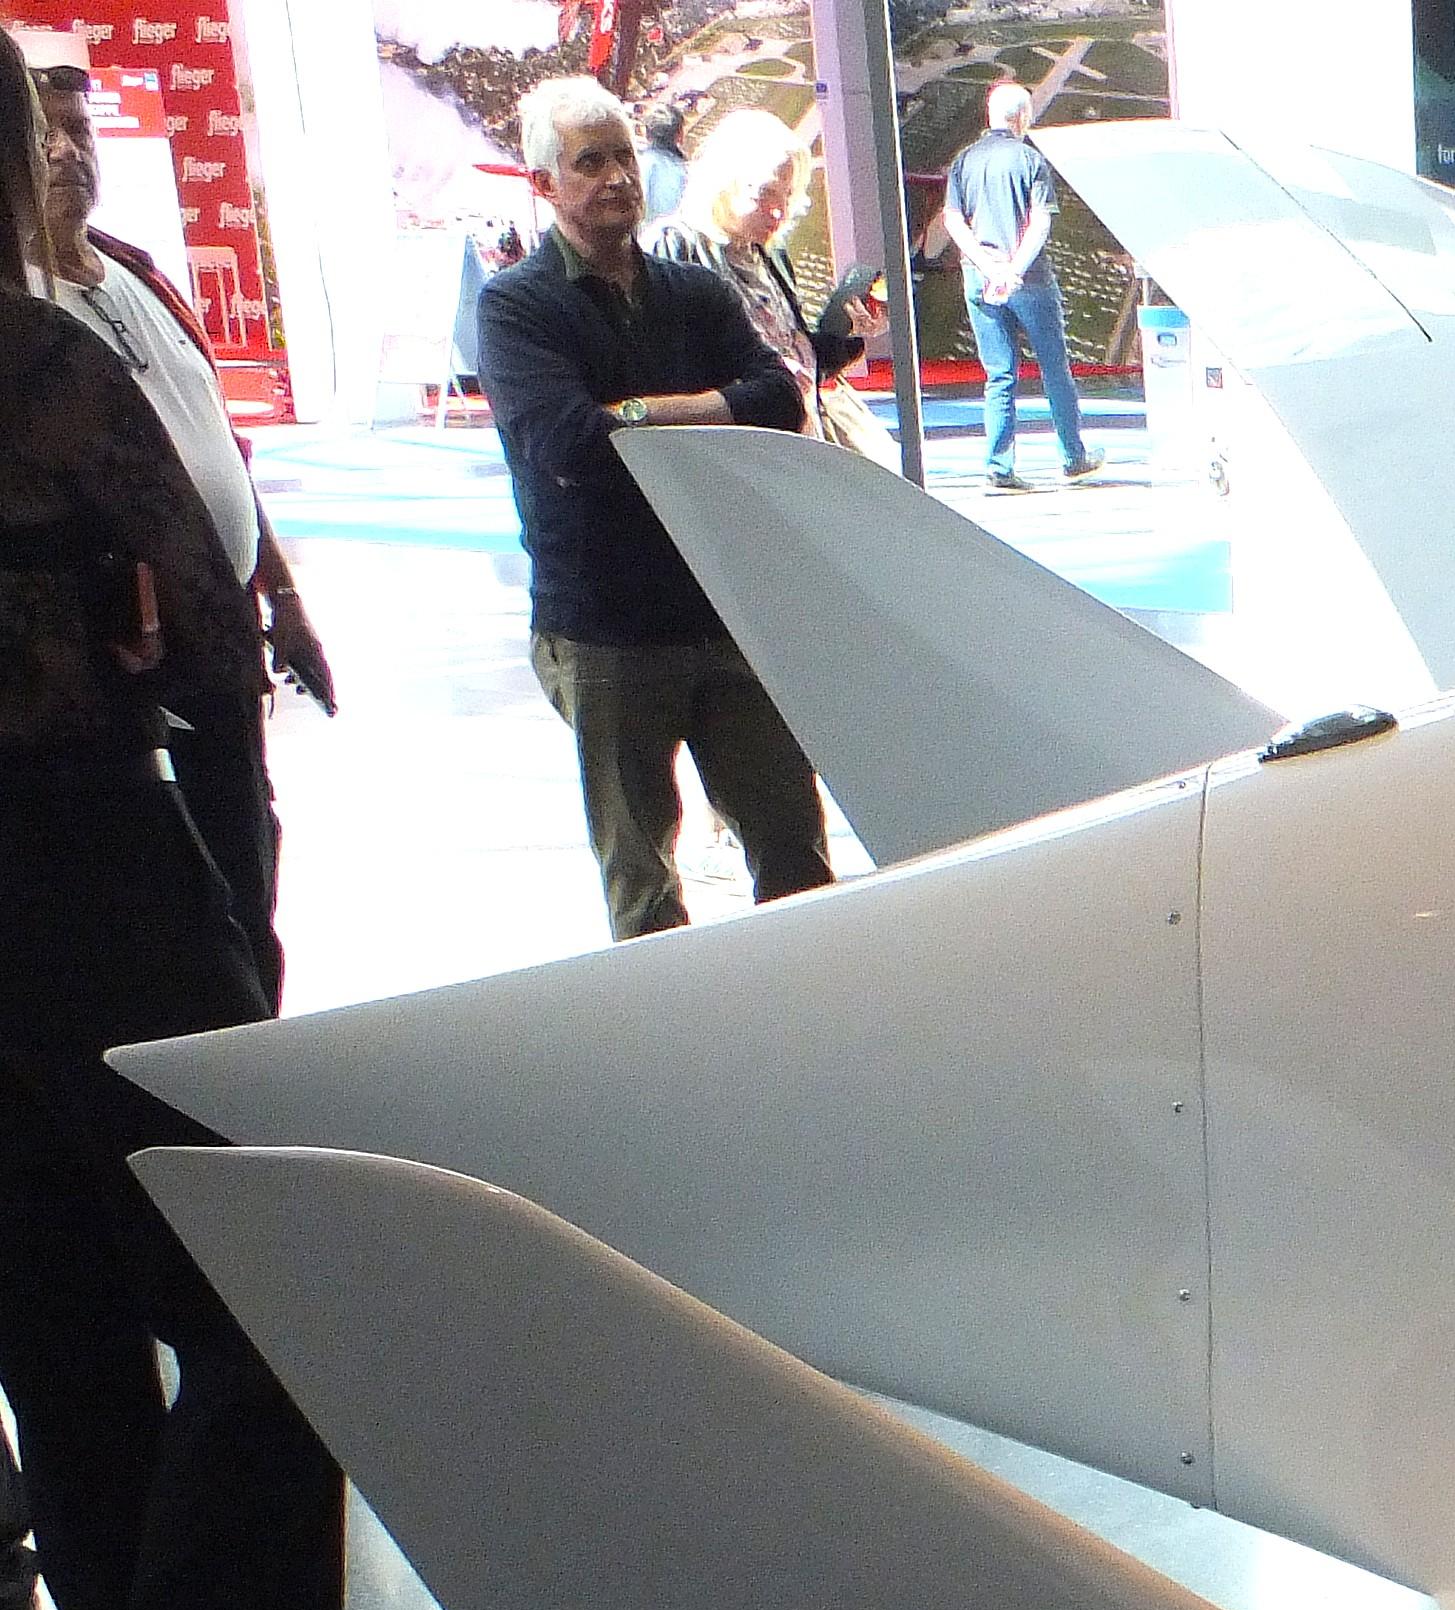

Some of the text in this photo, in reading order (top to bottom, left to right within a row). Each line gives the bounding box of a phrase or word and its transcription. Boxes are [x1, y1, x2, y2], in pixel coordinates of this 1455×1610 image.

[132, 16, 177, 45] flieger
[169, 63, 215, 91] flieger
[181, 156, 227, 182] flieger
